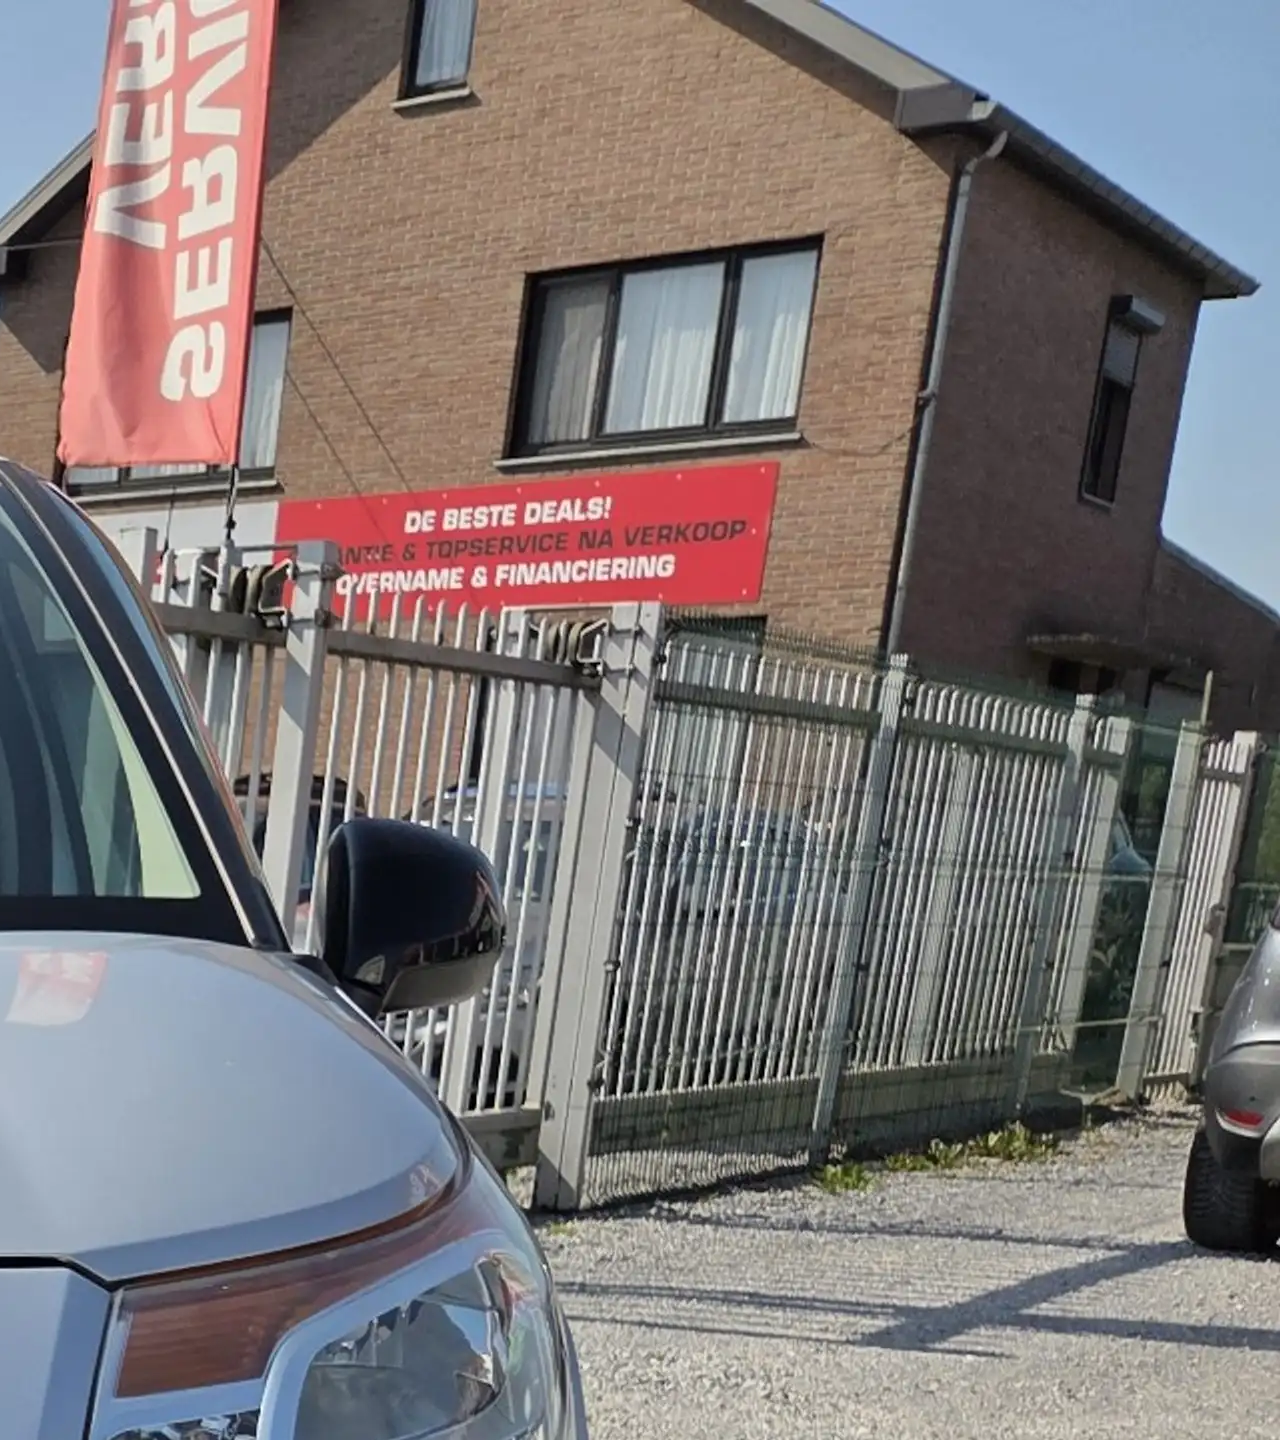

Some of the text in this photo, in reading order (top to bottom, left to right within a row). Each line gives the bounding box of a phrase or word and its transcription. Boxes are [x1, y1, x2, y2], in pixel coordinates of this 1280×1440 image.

[403, 496, 613, 534] DE BESTE DEALS!
[339, 519, 748, 566] NTIE & TOPSERVICE NA VERKOOP
[335, 553, 677, 596] OVERNAME & FINANCIERING
